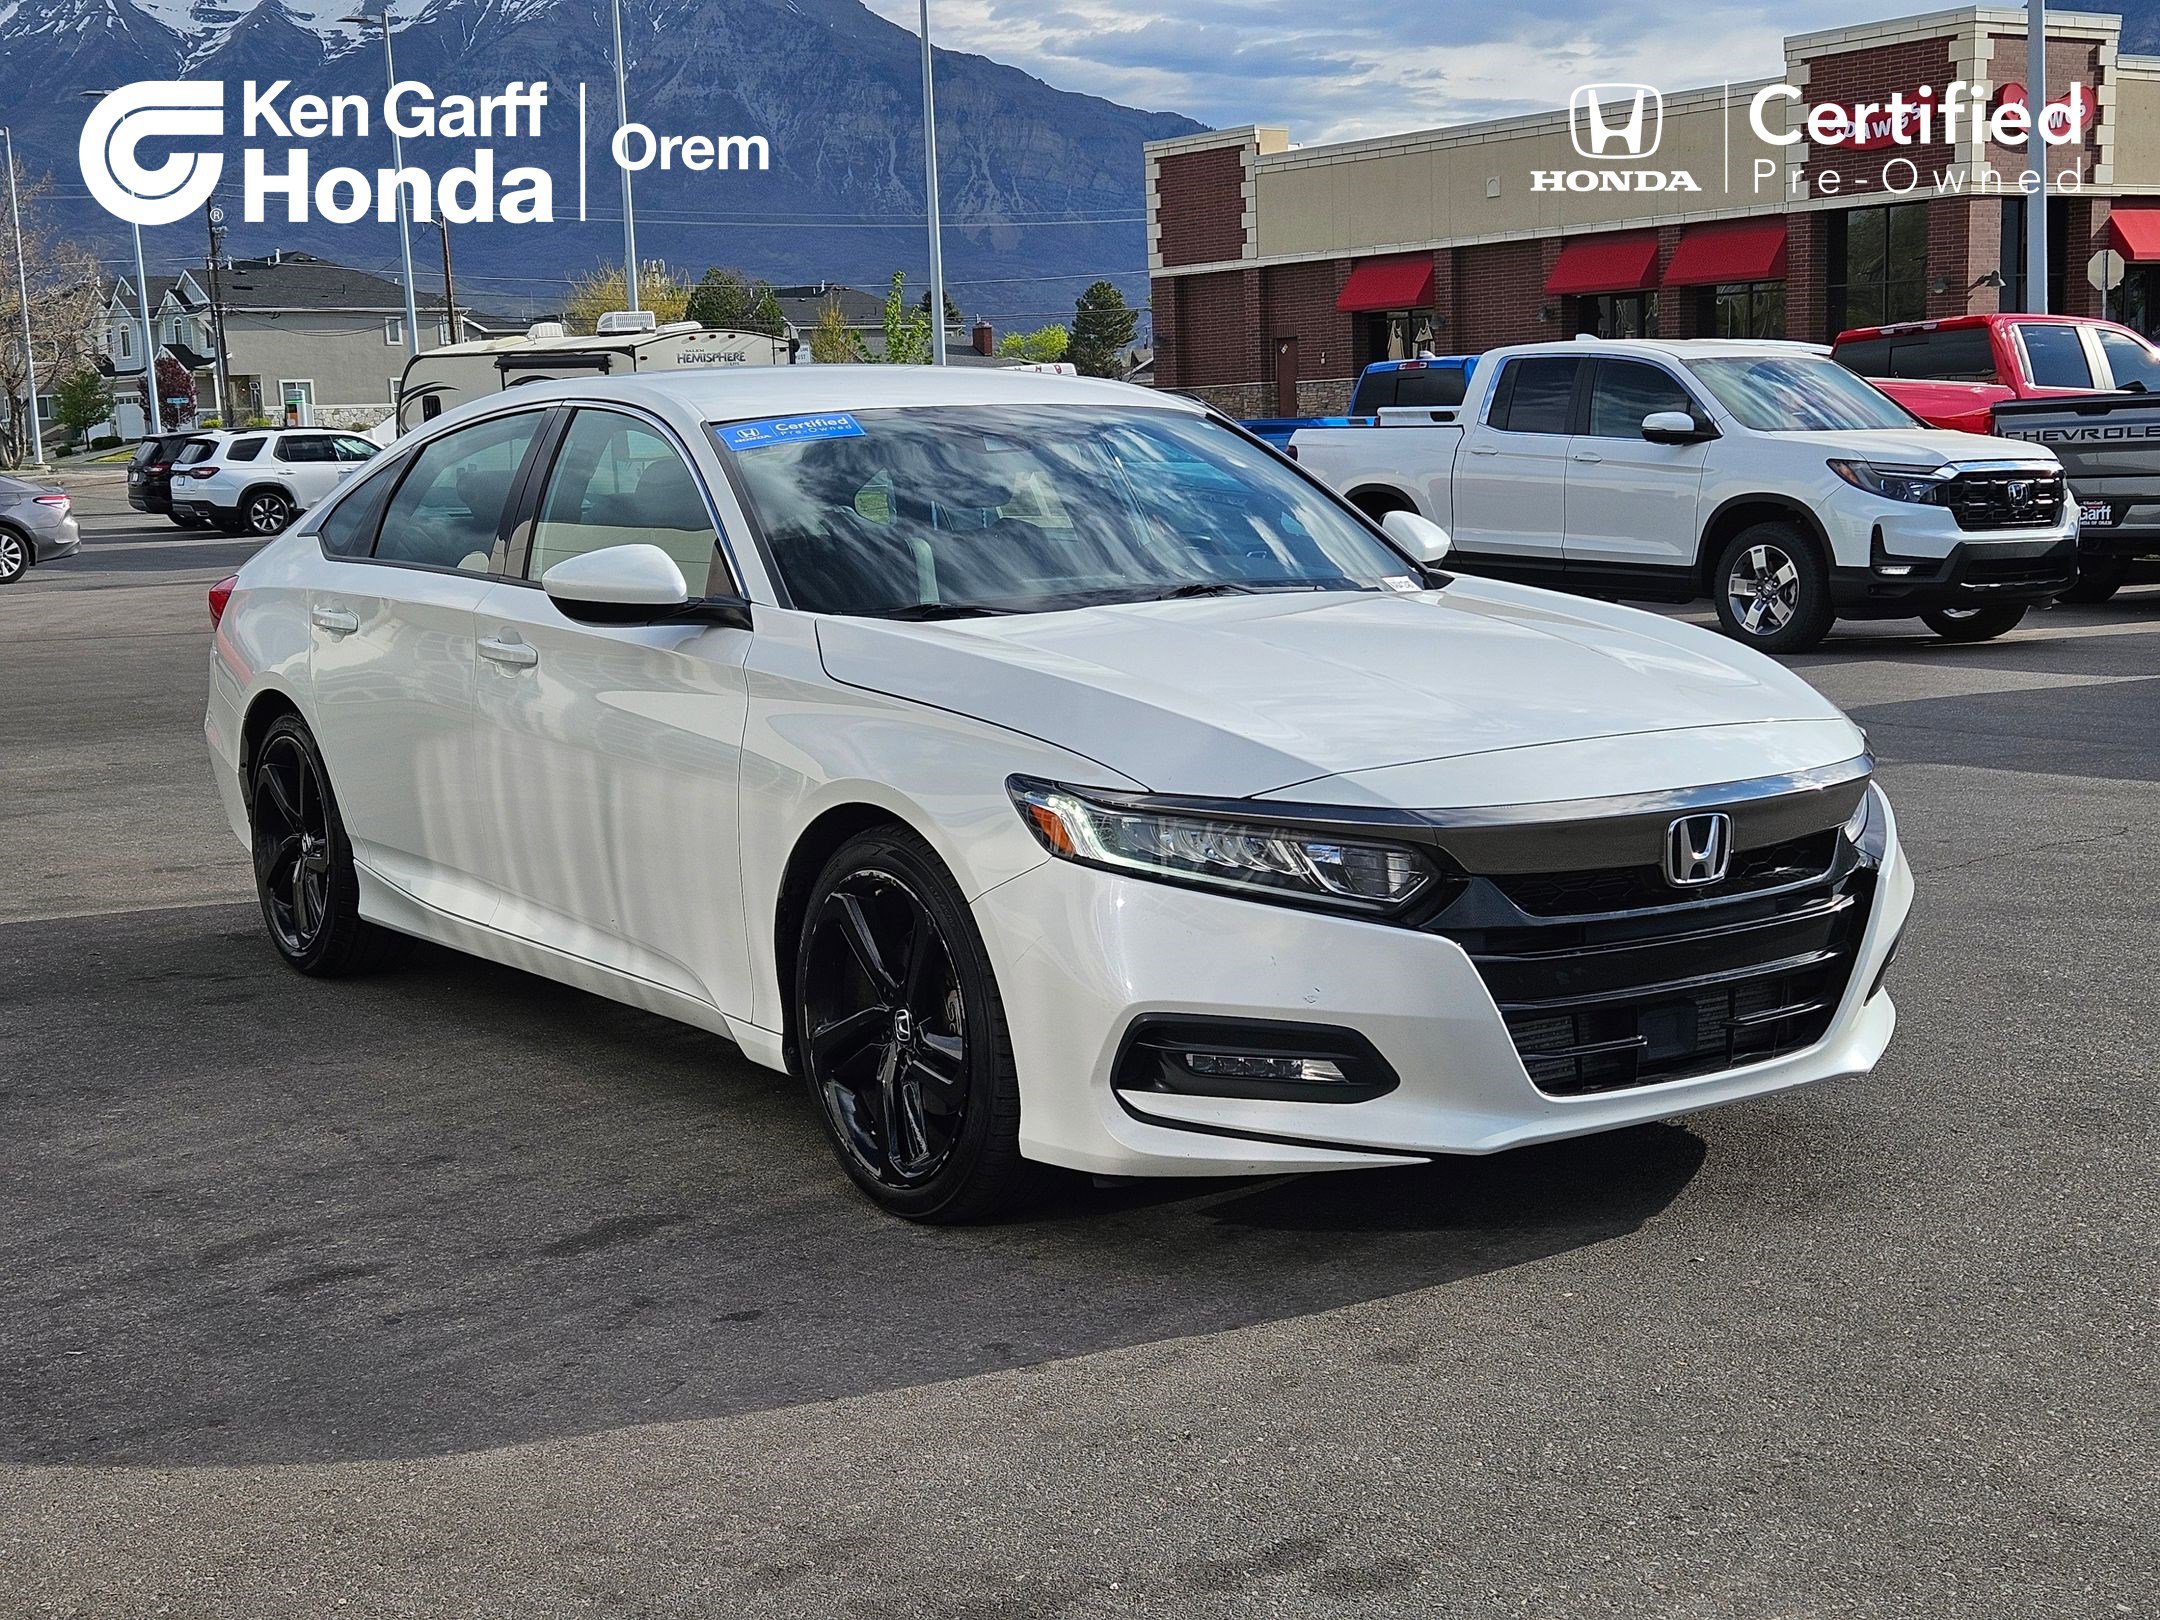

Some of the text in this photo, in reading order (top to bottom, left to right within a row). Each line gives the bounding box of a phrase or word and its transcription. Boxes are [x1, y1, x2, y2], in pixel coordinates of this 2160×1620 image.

[676, 351, 746, 364] HEMISPHERE
[775, 417, 849, 431] Certified
[780, 424, 853, 436] Pre-Owned
[734, 435, 773, 443] HONDA
[2079, 505, 2112, 520] Garff
